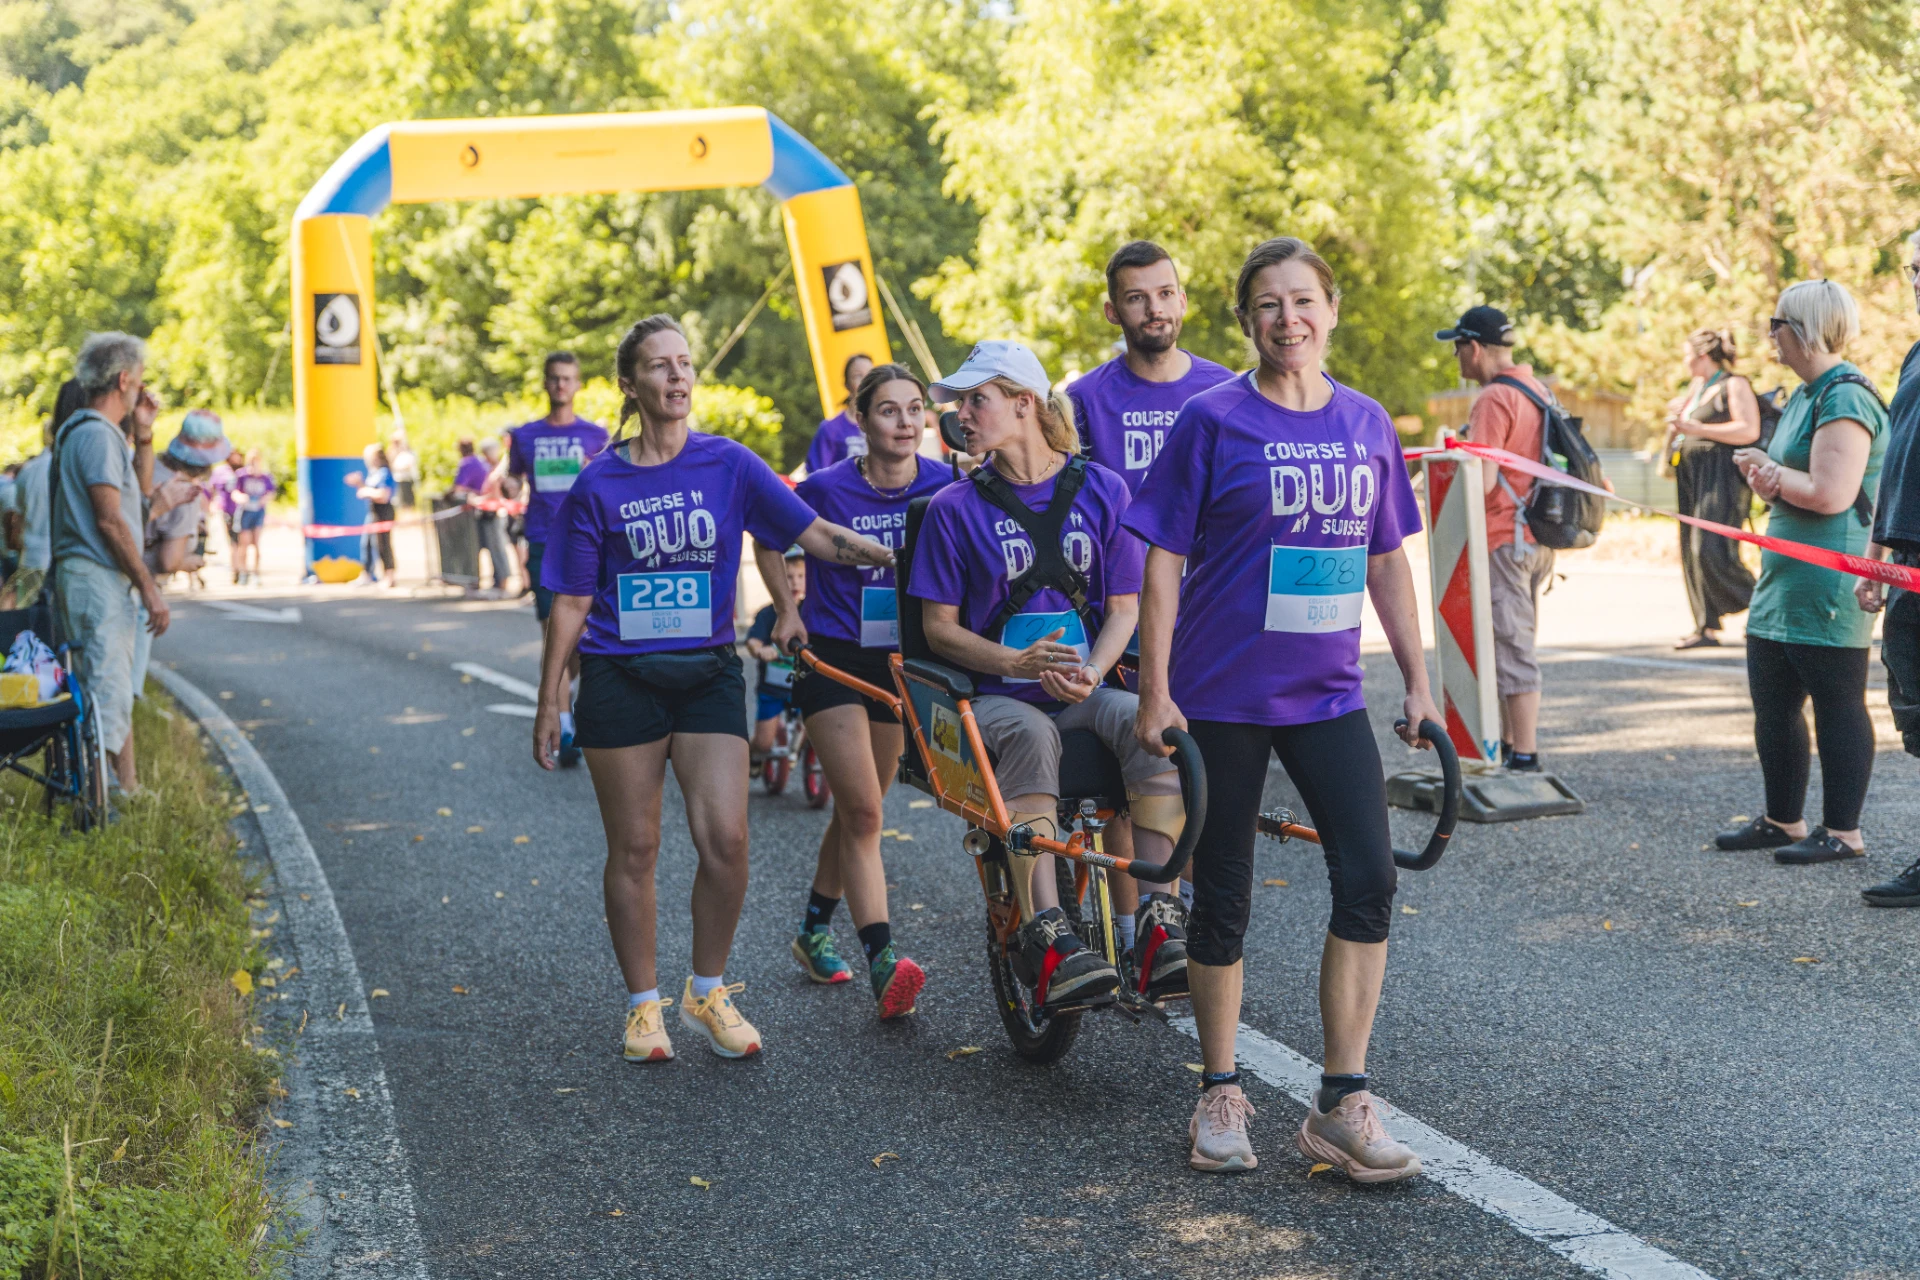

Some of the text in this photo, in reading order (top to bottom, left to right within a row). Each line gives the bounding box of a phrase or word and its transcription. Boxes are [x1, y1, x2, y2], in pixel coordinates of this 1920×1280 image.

[1263, 441, 1347, 461] COURSE
[1270, 464, 1375, 517] DUO
[620, 492, 684, 519] COURSE
[625, 508, 717, 560] DUO
[851, 511, 907, 531] COURS
[1321, 519, 1367, 537] SUISSE
[668, 549, 716, 564] SUISSE
[1001, 531, 1092, 581] DO
[1842, 554, 1913, 583] RAIFFEISEN
[1295, 555, 1356, 587] 228
[631, 577, 699, 610] 228
[652, 616, 682, 629] DUO
[1307, 604, 1338, 620] DUO
